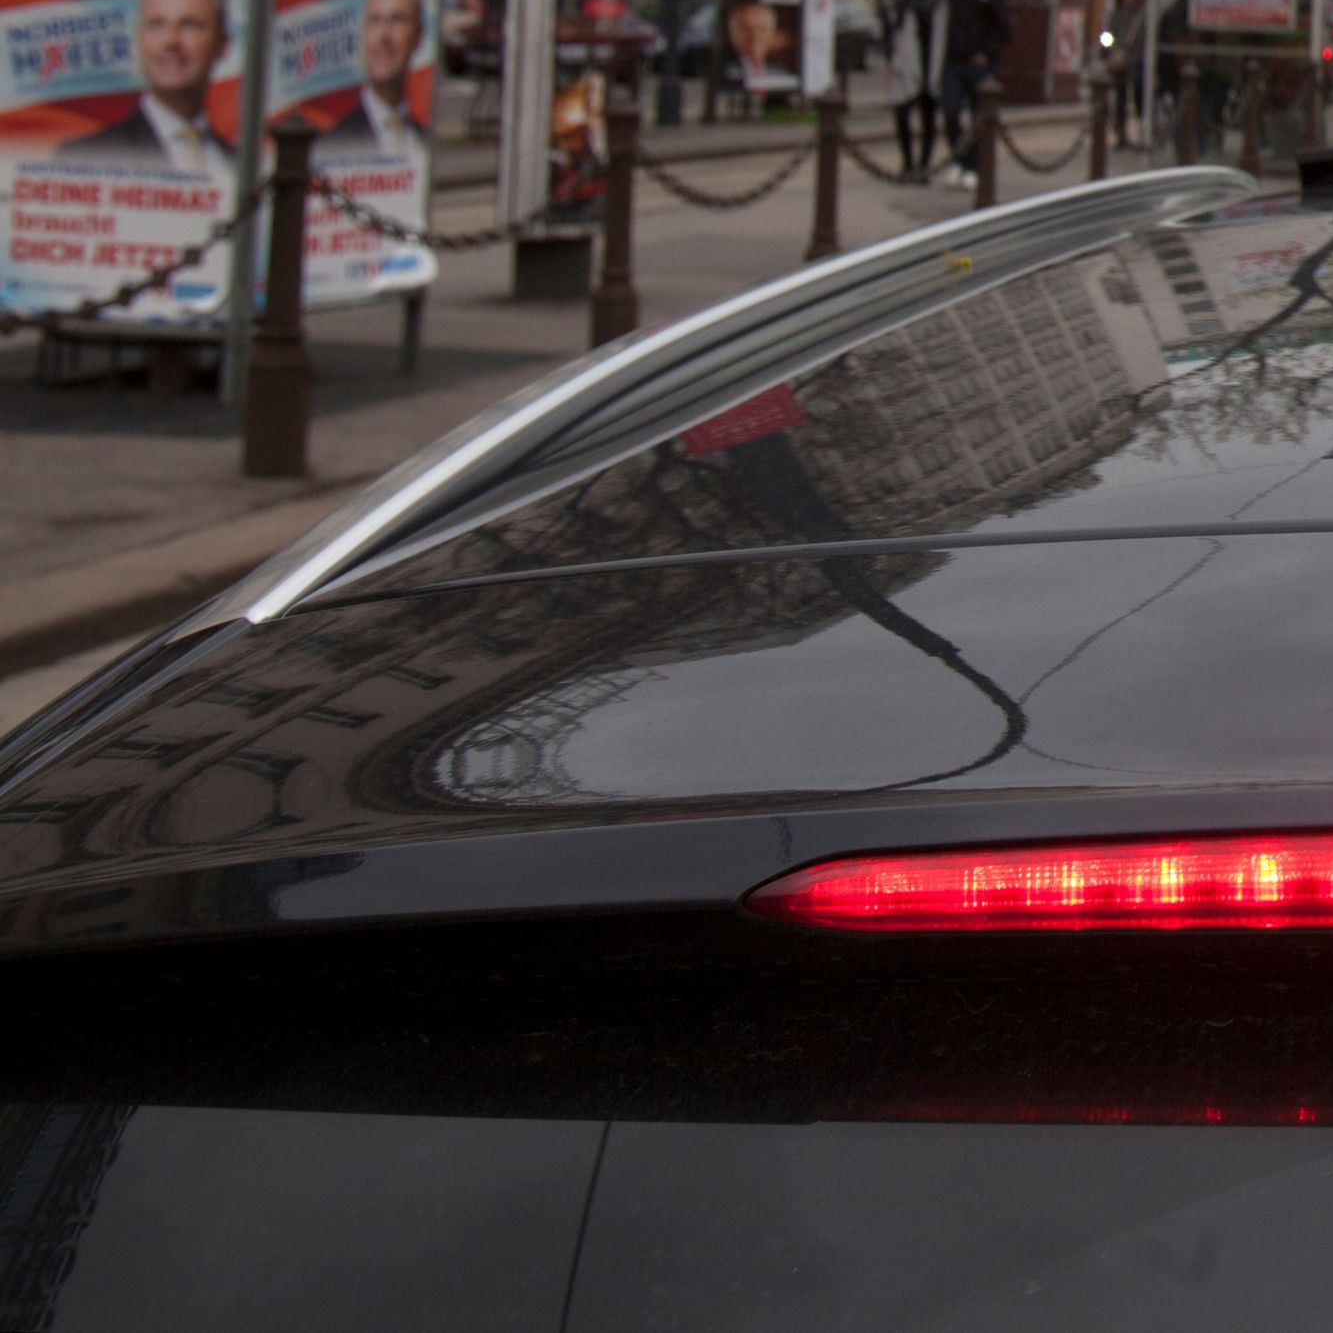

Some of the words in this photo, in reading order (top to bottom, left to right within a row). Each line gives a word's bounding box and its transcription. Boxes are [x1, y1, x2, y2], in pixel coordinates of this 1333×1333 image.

[13, 180, 100, 204] DEINE
[109, 186, 220, 211] HEIMAT
[11, 237, 85, 263] DICH
